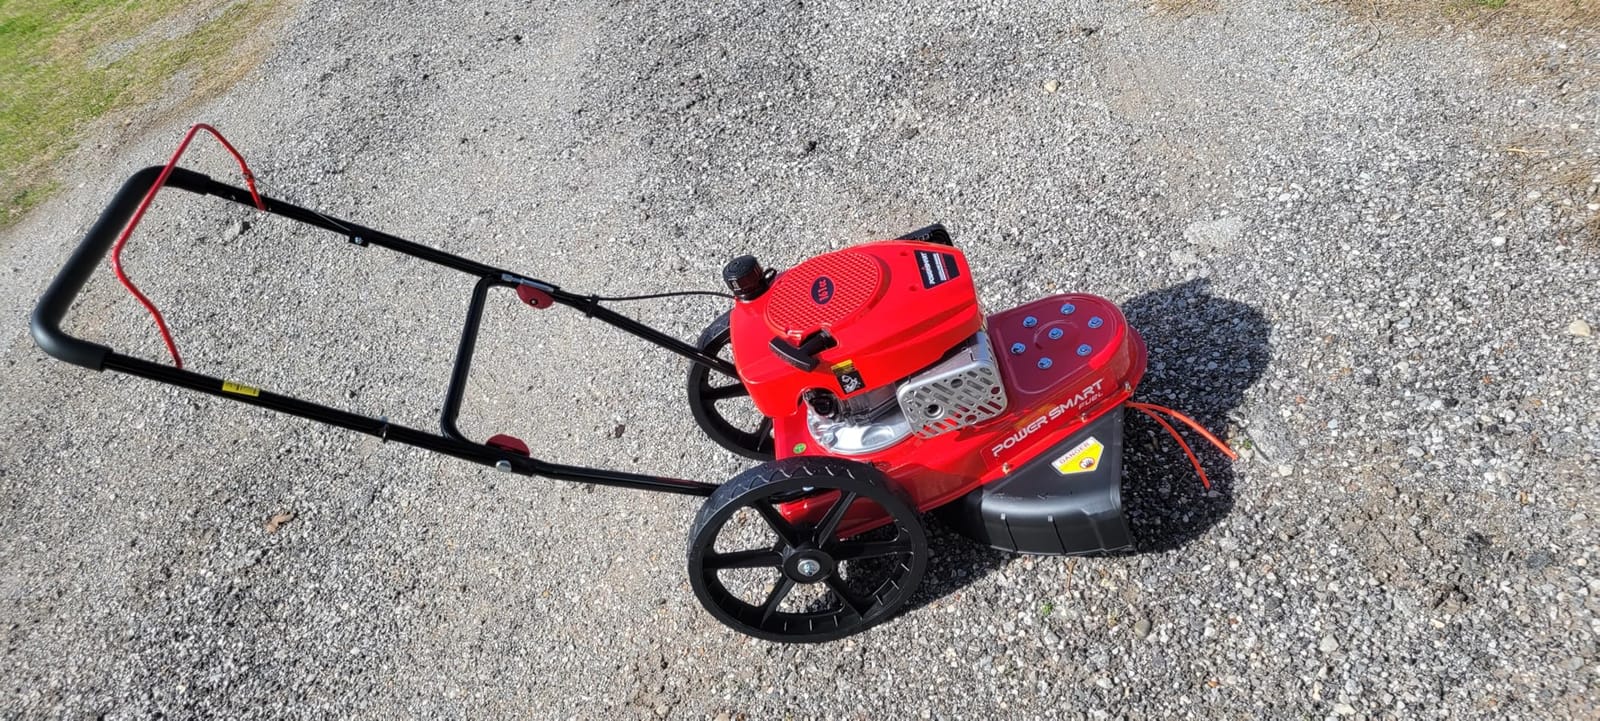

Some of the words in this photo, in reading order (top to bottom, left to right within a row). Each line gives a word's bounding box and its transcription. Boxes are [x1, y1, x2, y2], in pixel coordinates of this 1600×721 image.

[1078, 392, 1104, 410] FUEL
[991, 415, 1048, 457] POWER
[1048, 378, 1104, 420] SMART
[1059, 441, 1091, 464] DANGER
